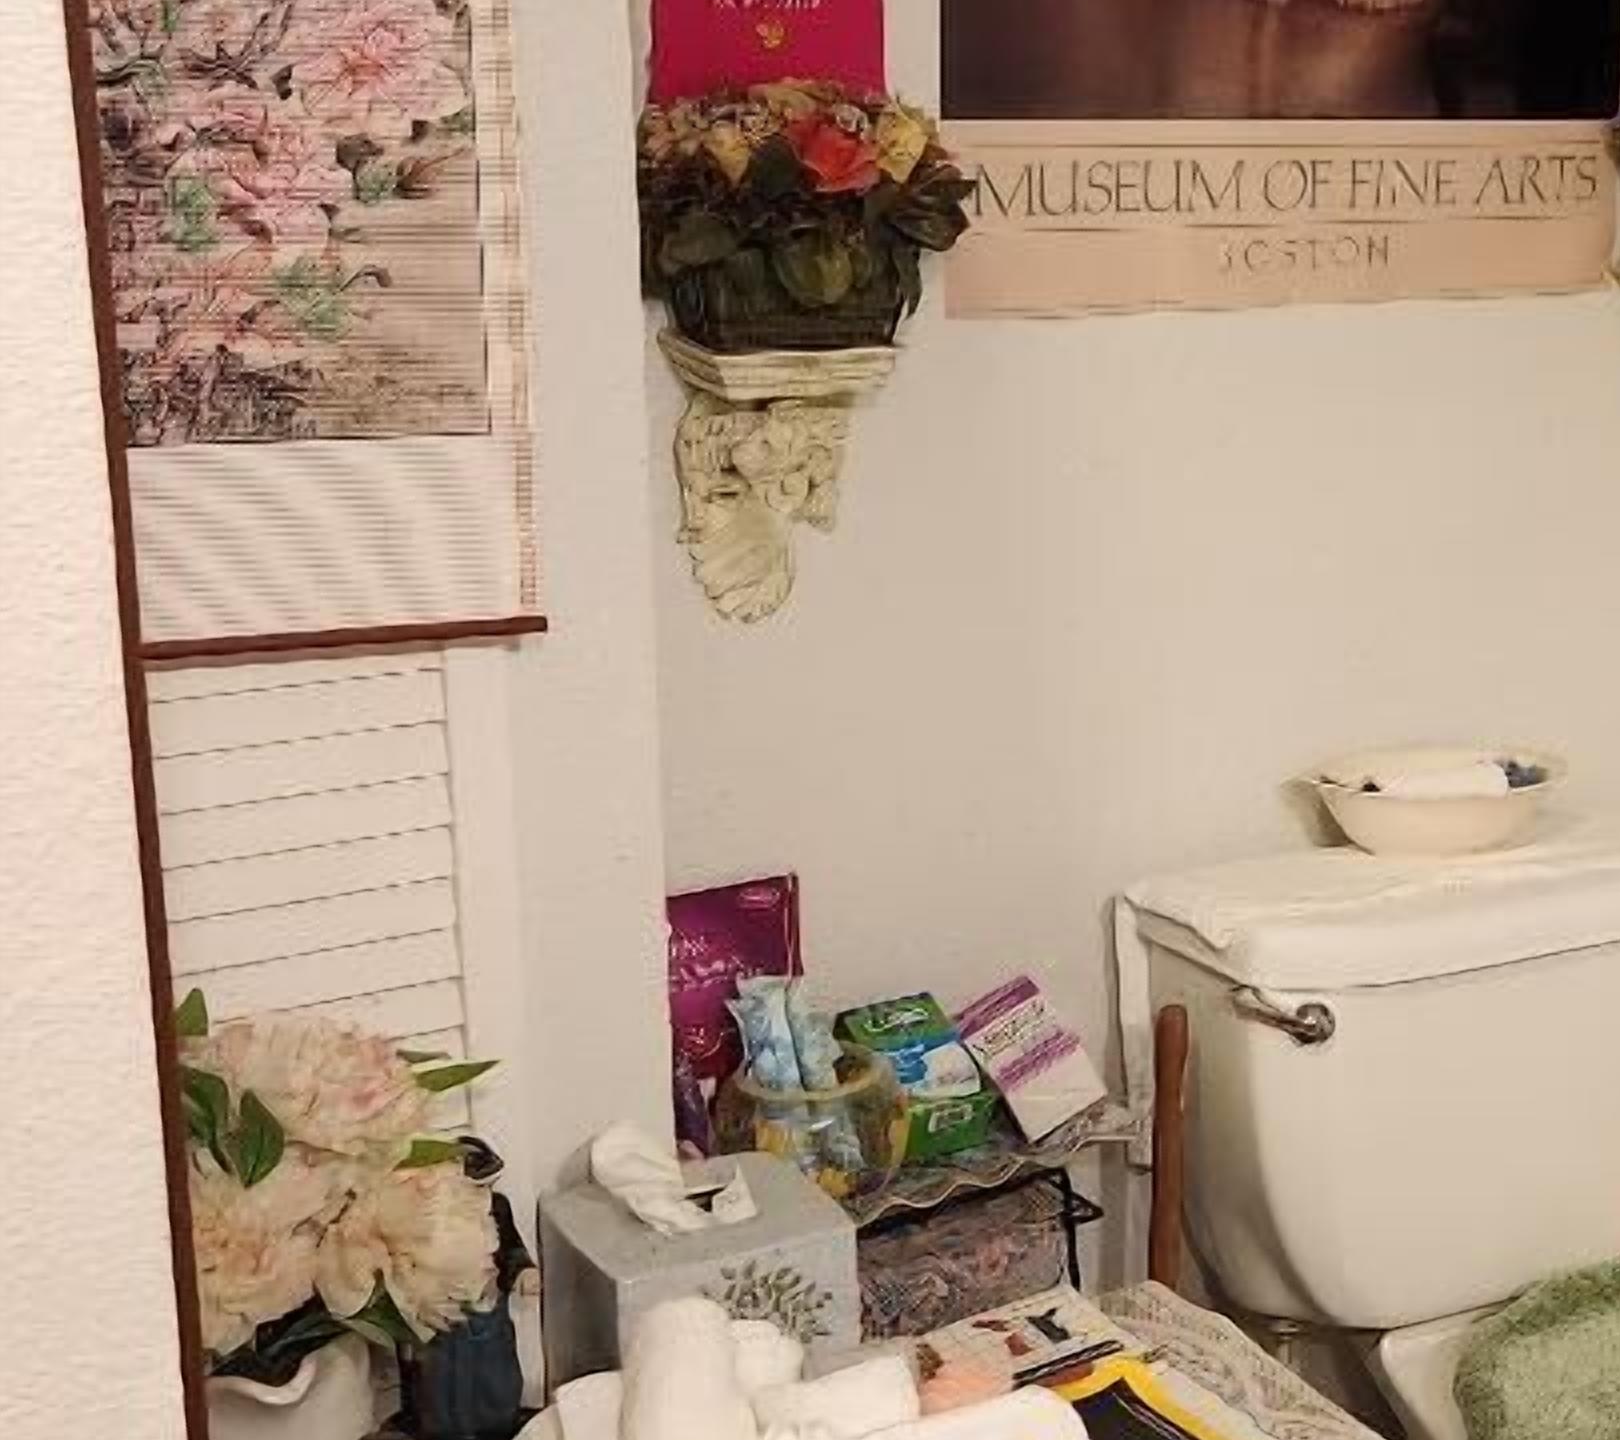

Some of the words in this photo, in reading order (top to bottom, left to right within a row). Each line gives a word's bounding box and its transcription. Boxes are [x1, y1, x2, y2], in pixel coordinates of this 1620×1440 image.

[974, 158, 1245, 216] MUSEUM
[1263, 158, 1333, 212] OF
[1349, 157, 1457, 209] FINE
[1475, 155, 1598, 206] ARTS
